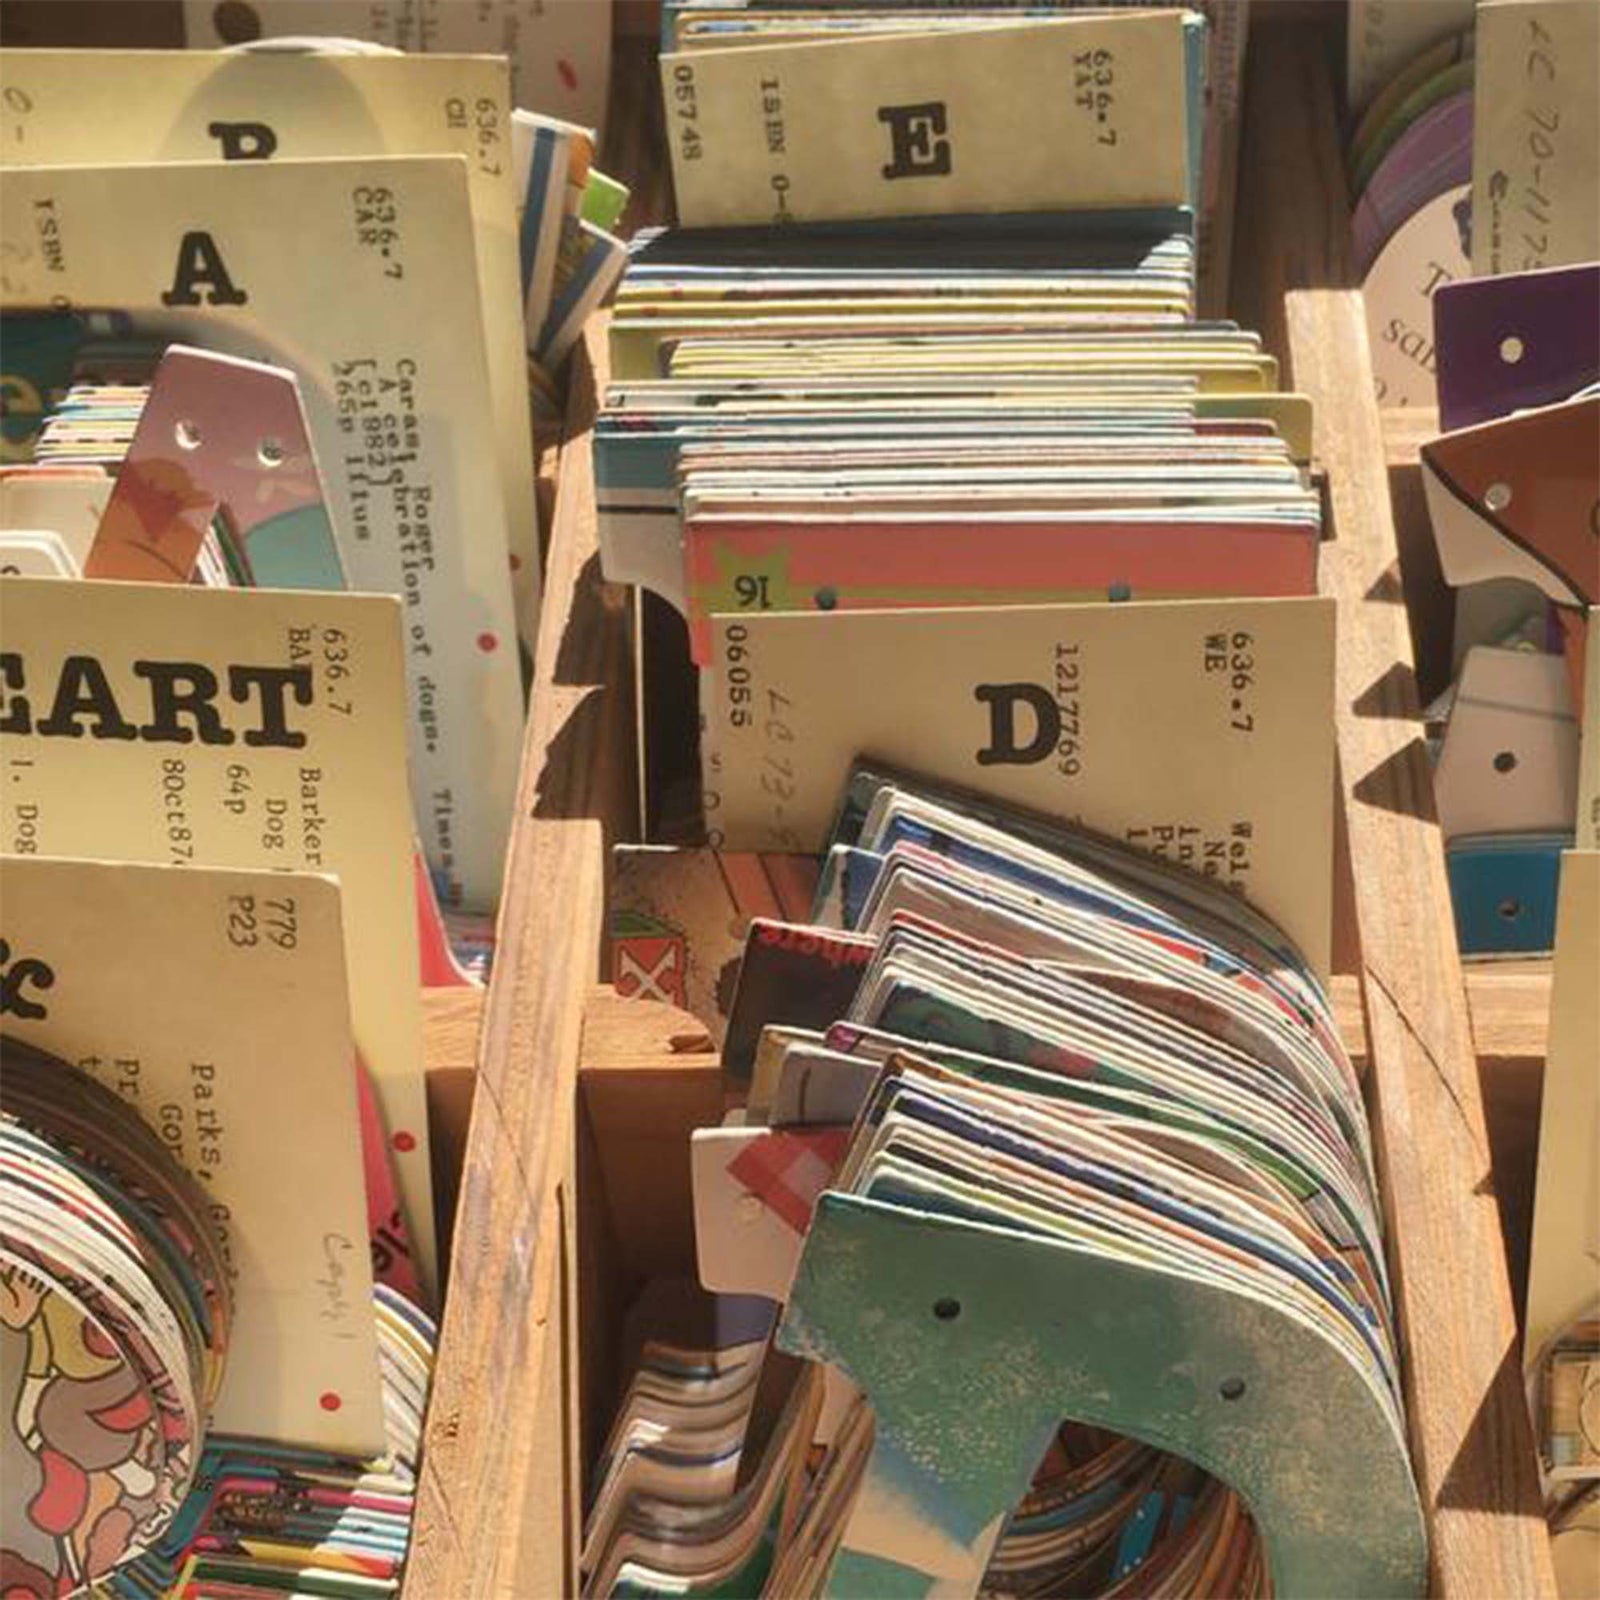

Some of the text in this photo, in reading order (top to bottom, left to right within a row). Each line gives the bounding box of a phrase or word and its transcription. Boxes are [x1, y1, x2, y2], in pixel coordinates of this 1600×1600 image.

[673, 65, 702, 161] 05748
[759, 80, 789, 154] ISBN
[1093, 49, 1118, 147] 636.7
[475, 97, 500, 177] 636.7
[877, 102, 951, 179] E
[34, 198, 66, 274] ISBN
[353, 185, 381, 247] CAR
[374, 186, 403, 281] 636.7
[161, 231, 248, 306] A
[379, 378, 398, 393] A
[381, 413, 423, 607] celebration
[411, 486, 436, 573] Roger
[734, 575, 772, 610] 16
[287, 626, 312, 669] BA
[322, 627, 353, 717] 636.7
[412, 624, 433, 656] of
[725, 624, 753, 728] 06055
[1205, 635, 1229, 672] WE
[418, 675, 438, 754] dogs.
[1054, 643, 1081, 777] 1217769
[1231, 631, 1255, 733] 636.7
[974, 683, 1060, 767] D
[225, 764, 252, 815] 64p
[263, 799, 286, 850] Dog
[299, 766, 323, 867] Barker
[14, 803, 39, 855] Dog
[228, 894, 259, 950] P23
[267, 897, 298, 951] 779
[191, 1063, 224, 1181] Parks,
